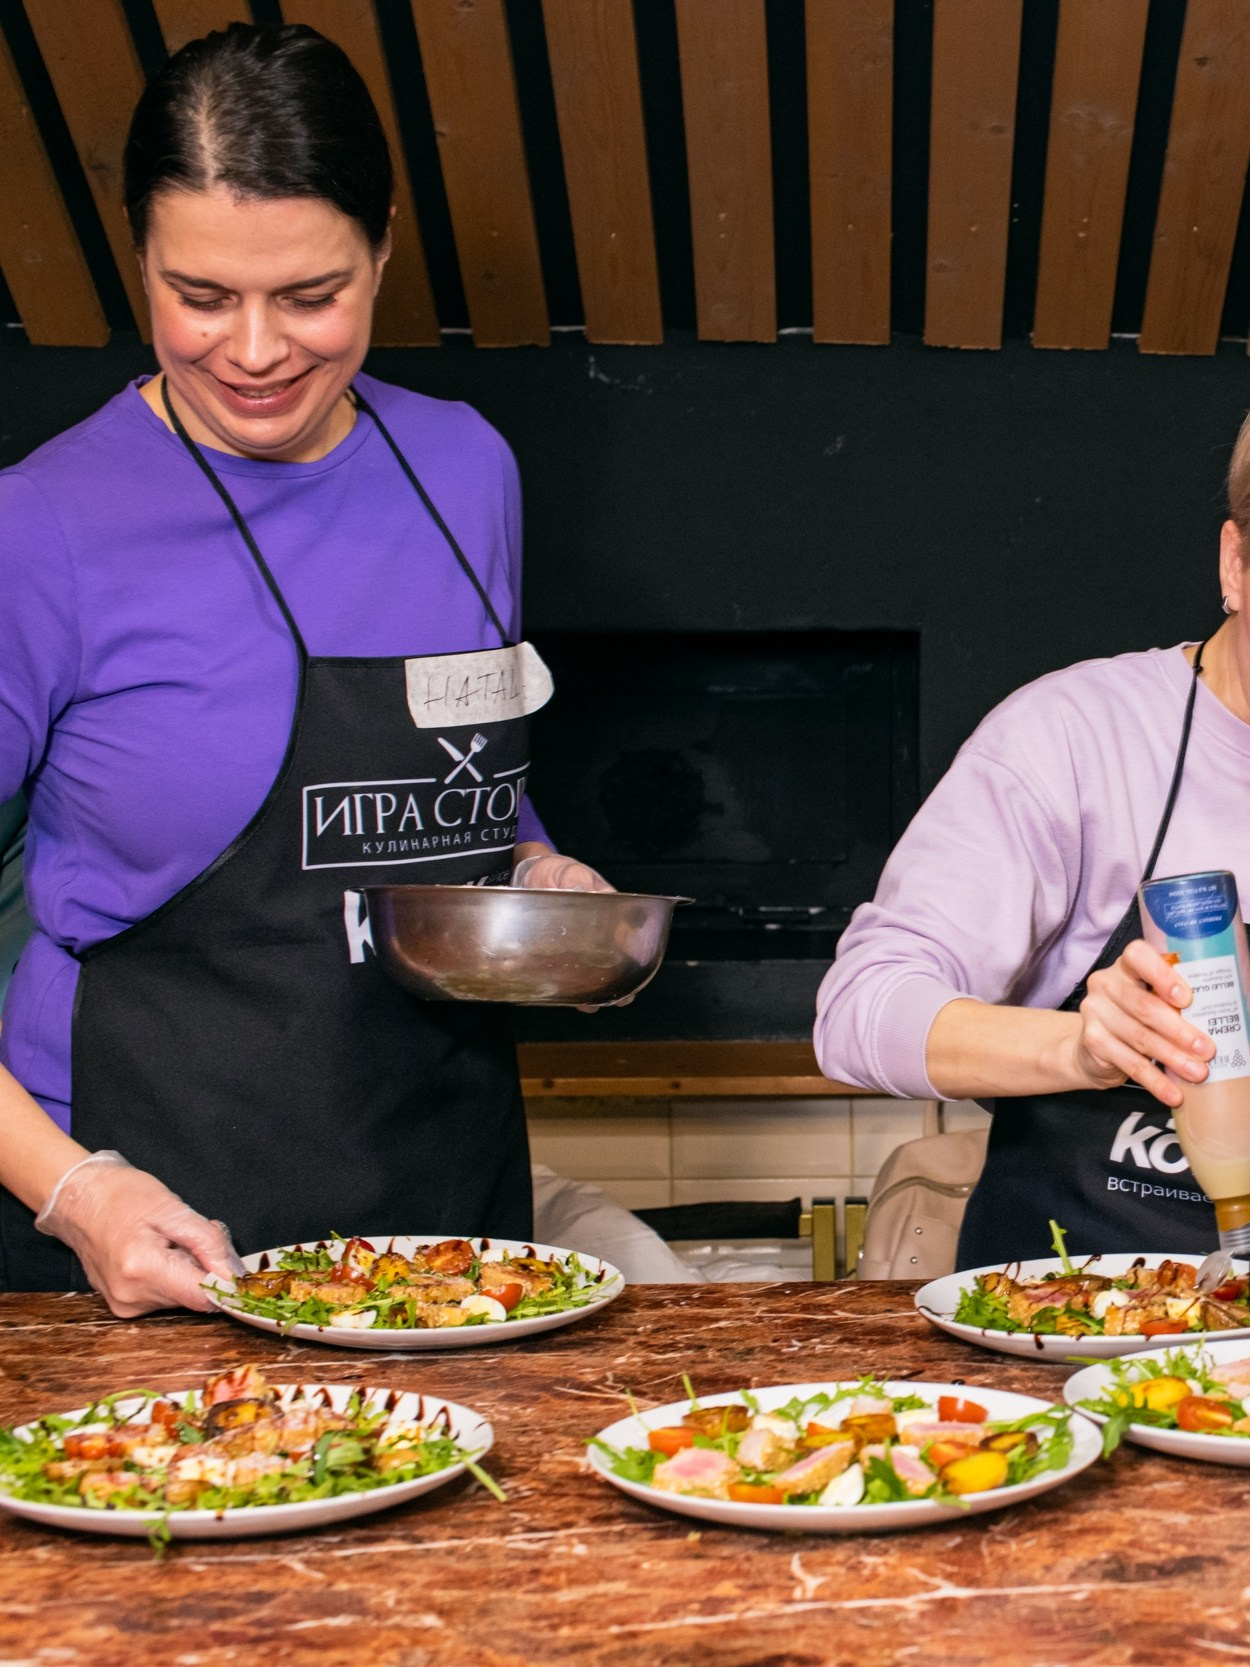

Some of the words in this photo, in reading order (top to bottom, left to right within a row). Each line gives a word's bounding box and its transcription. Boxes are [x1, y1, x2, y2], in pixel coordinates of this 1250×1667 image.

[313, 792, 424, 838] ИГРА
[361, 831, 472, 855] КУЛИНАРНАЯ
[1211, 981, 1235, 991] BELLEI
[1207, 1014, 1240, 1027] BELLEI
[1207, 1023, 1242, 1036] CREMA
